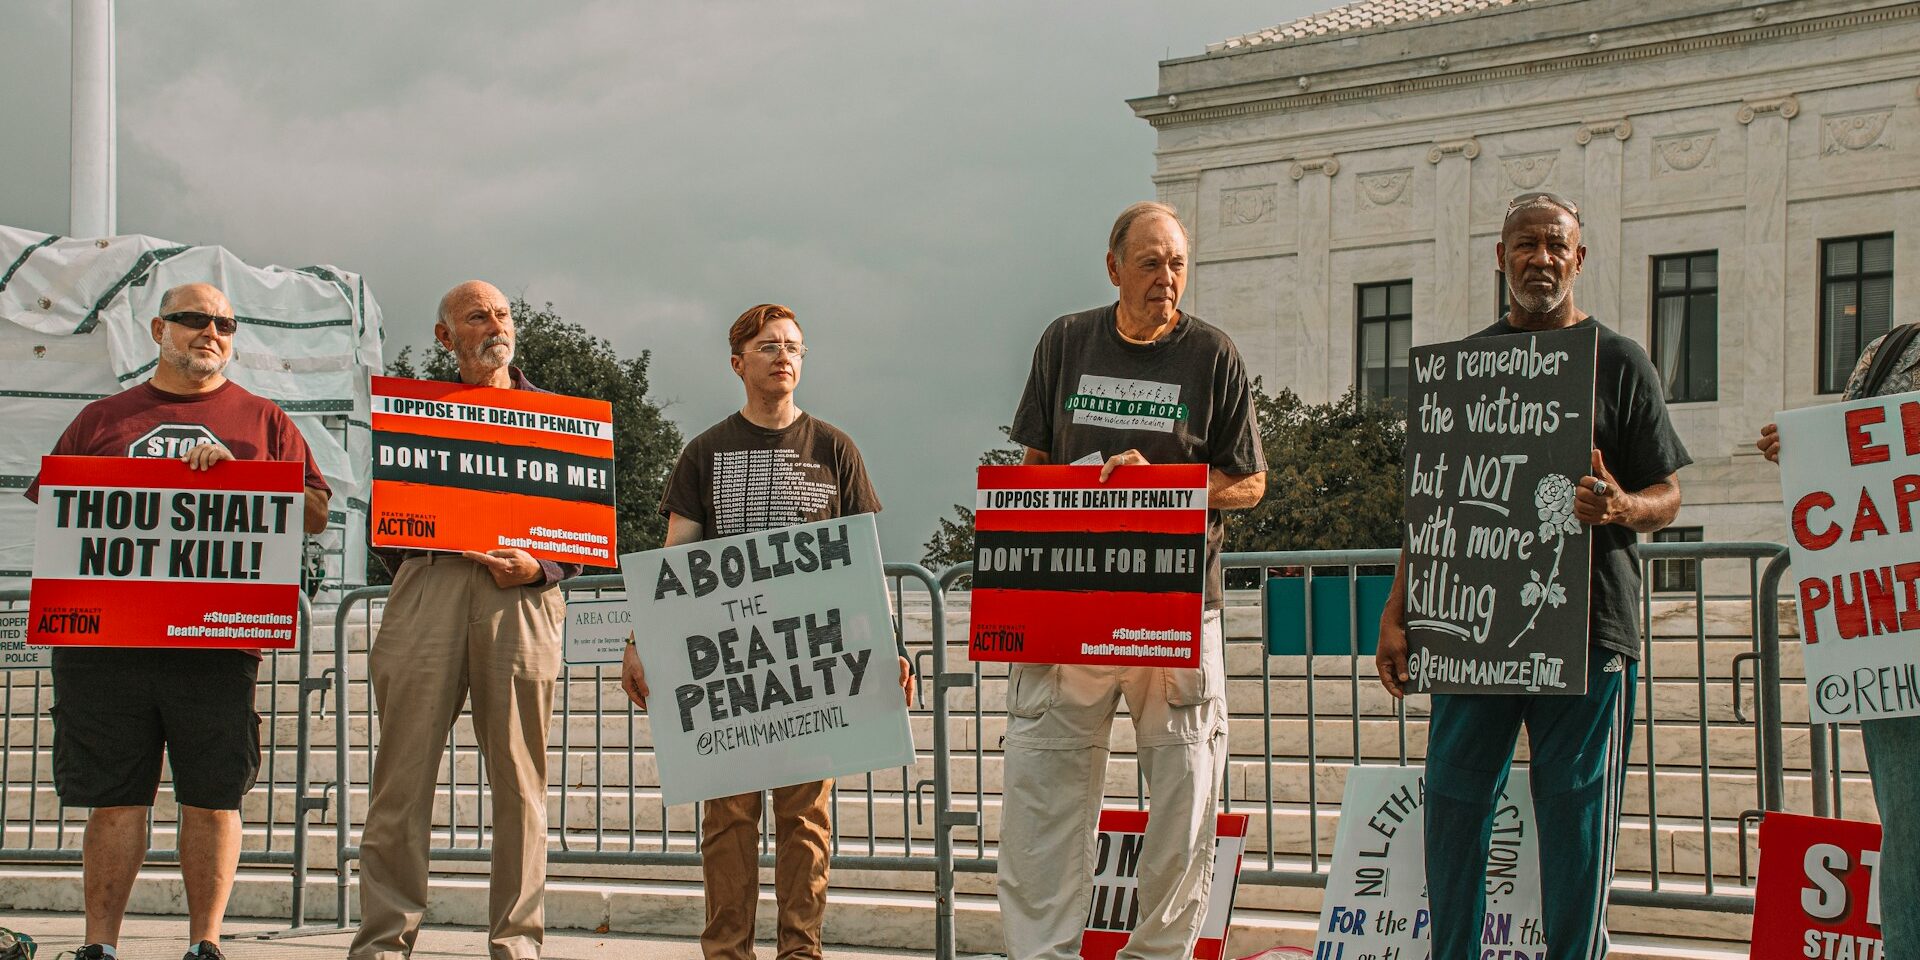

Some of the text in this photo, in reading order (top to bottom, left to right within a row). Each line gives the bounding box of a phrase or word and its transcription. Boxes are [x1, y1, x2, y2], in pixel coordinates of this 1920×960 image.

[1414, 335, 1569, 383] we remember
[384, 398, 600, 436] I OPPOSE THE DEATH PENALTY
[1068, 397, 1183, 418] JOURNEY OF HOPE
[1419, 391, 1454, 434] the
[380, 445, 607, 490] DON'T KILL FOR ME!
[1411, 453, 1528, 501] but NOT
[53, 489, 294, 534] THOU SHALT
[987, 490, 1193, 508] I OPPOSE THE DEATH PENALTY
[1791, 474, 1920, 551] CAP
[377, 517, 435, 538] ACTION
[529, 526, 608, 544] #StopExecutions
[1409, 506, 1535, 560] with more
[79, 537, 263, 580] NOT KILL!
[498, 535, 609, 559] DeathPenaltyAction.org
[654, 524, 852, 601] ABOLISH
[978, 548, 1196, 574] DON'T KILL FOR ME!
[721, 594, 767, 621] THE
[1407, 560, 1496, 644] killing
[0, 618, 27, 627] OPER
[37, 613, 100, 634] ACTION
[203, 612, 292, 625] #StopExecutions
[575, 612, 603, 625] AREA
[0, 641, 26, 650] REME
[167, 625, 292, 640] DeathPenaltyAction.org
[686, 608, 844, 681] DEATH
[973, 632, 1024, 652] ACTION
[1112, 628, 1192, 641] #StopExecutions
[5, 653, 38, 663] POLICE
[1081, 643, 1191, 658] DeathPenaltyAction.org
[675, 649, 872, 733] PENALTY
[696, 706, 849, 756] @REHUMANIZEINTL
[1354, 868, 1384, 896] NO
[1375, 910, 1407, 936] the
